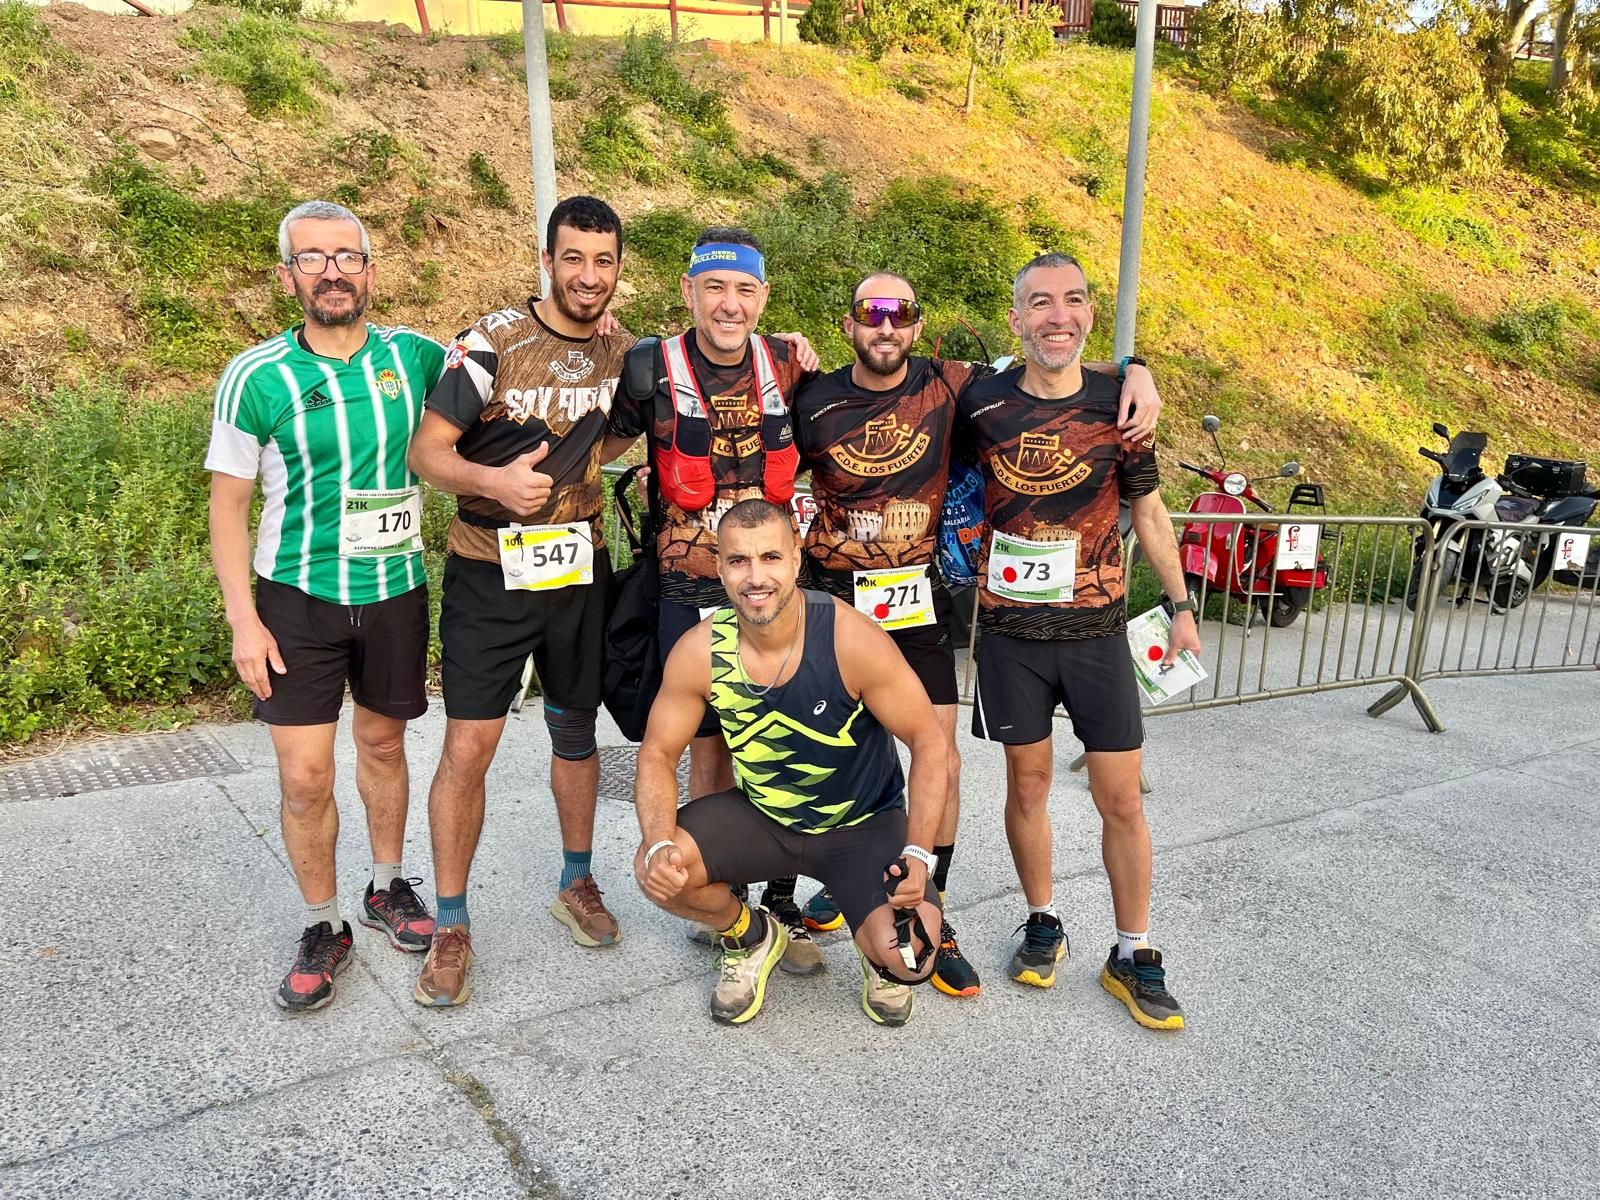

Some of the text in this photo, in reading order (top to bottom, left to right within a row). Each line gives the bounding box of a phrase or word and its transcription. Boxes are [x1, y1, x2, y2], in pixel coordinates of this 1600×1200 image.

[506, 386, 553, 419] SOY
[740, 440, 760, 454] FUE
[836, 437, 927, 476] C.D.E. LOS FUERTES
[994, 461, 1087, 492] C.D.E. LOS FUERTES
[347, 501, 368, 510] 21K
[378, 510, 411, 533] 170
[533, 542, 579, 567] 547
[995, 541, 1010, 553] 21K
[1022, 561, 1051, 581] 73
[883, 583, 920, 608] 271
